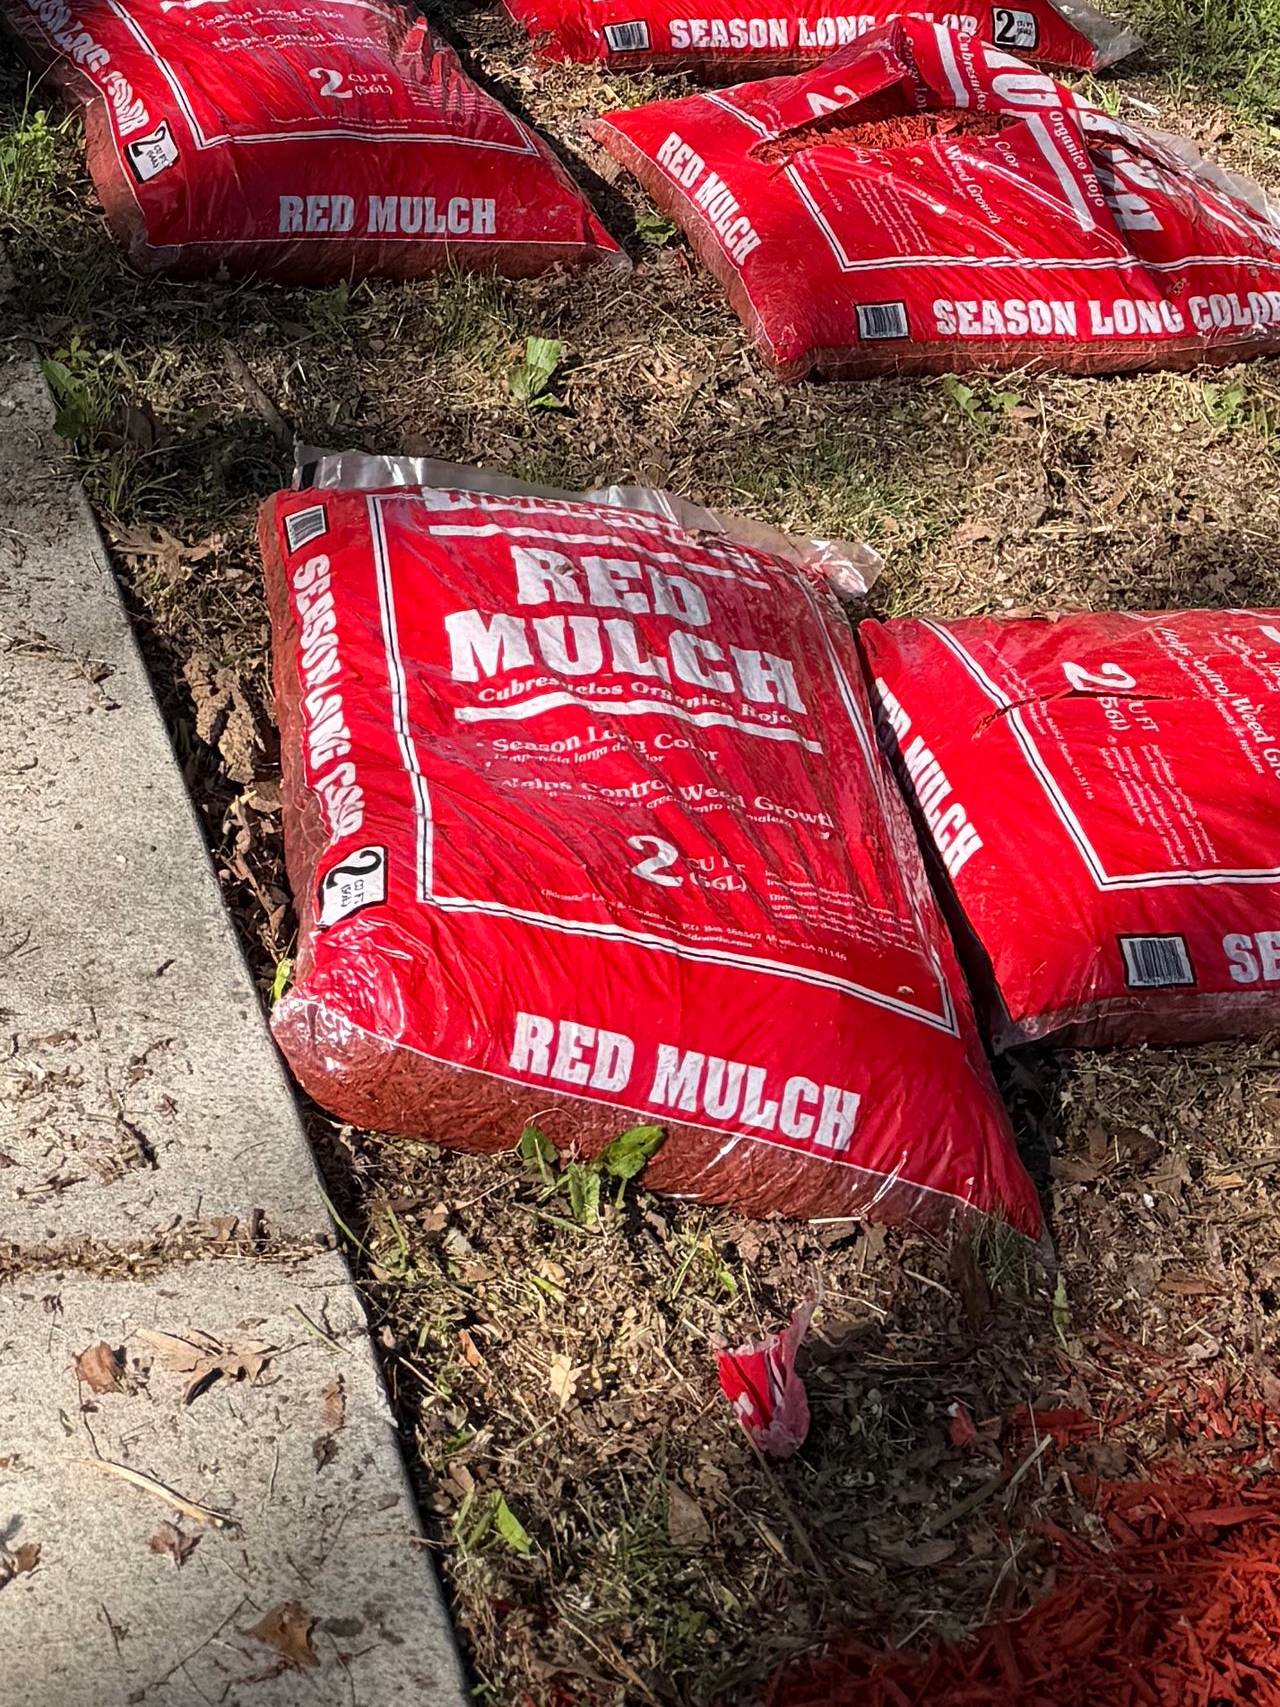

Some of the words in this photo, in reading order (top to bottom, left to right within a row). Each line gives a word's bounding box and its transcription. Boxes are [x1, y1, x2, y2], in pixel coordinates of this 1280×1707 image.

[668, 18, 790, 49] SEASON
[797, 14, 877, 47] LONG
[996, 10, 1017, 44] 2
[308, 66, 354, 99] 2
[1047, 109, 1088, 173] Organico
[1082, 169, 1106, 208] Rojo
[279, 195, 355, 234] RED
[367, 196, 497, 236] MULCH
[656, 131, 706, 188] RED
[694, 170, 762, 266] MULCH
[933, 298, 1078, 337] SEASON
[1090, 299, 1184, 337] LONG
[509, 544, 713, 628] RED
[291, 552, 343, 692] SEASON
[443, 607, 809, 716] MULCH
[741, 700, 795, 726] Rojo
[1060, 661, 1138, 692] 2
[1135, 715, 1161, 733] FT
[1097, 695, 1132, 733] 56L)
[1229, 696, 1276, 744] Weed
[491, 734, 582, 753] Season
[903, 734, 985, 879] MULCH
[326, 850, 382, 890] 2
[625, 834, 685, 889] 2
[508, 1010, 636, 1094] RED
[647, 1042, 863, 1153] MULCH
